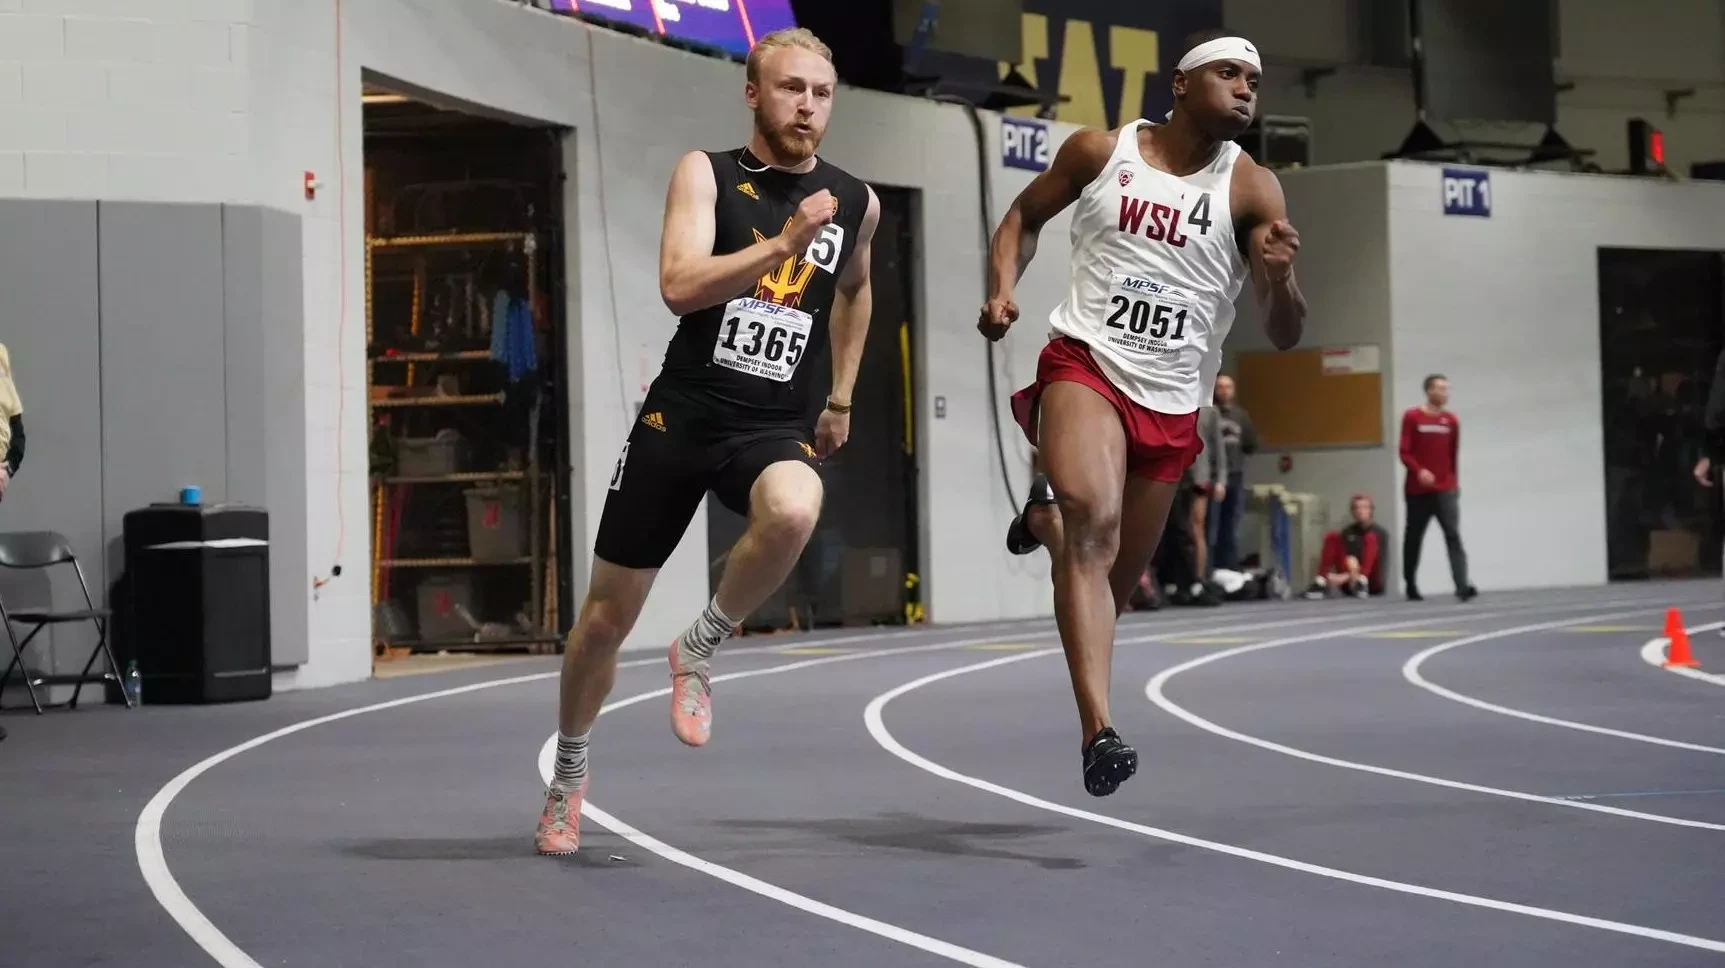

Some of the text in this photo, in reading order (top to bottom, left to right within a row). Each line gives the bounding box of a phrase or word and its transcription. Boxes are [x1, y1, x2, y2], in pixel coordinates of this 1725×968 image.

[1002, 123, 1049, 164] PIT 2
[1444, 177, 1490, 209] PIT 1
[1187, 192, 1213, 236] 4
[811, 226, 838, 266] 5
[1122, 277, 1170, 294] MPSF
[739, 298, 787, 315] MPSF
[1106, 294, 1187, 340] 2051
[721, 316, 806, 367] 1365
[1107, 335, 1138, 349] UNIVERSITY
[1138, 342, 1146, 351] OF
[1123, 332, 1147, 344] DEMPSEY
[720, 357, 751, 372] UNIVERSITY
[736, 354, 783, 372] DEMPSEY INDOOR
